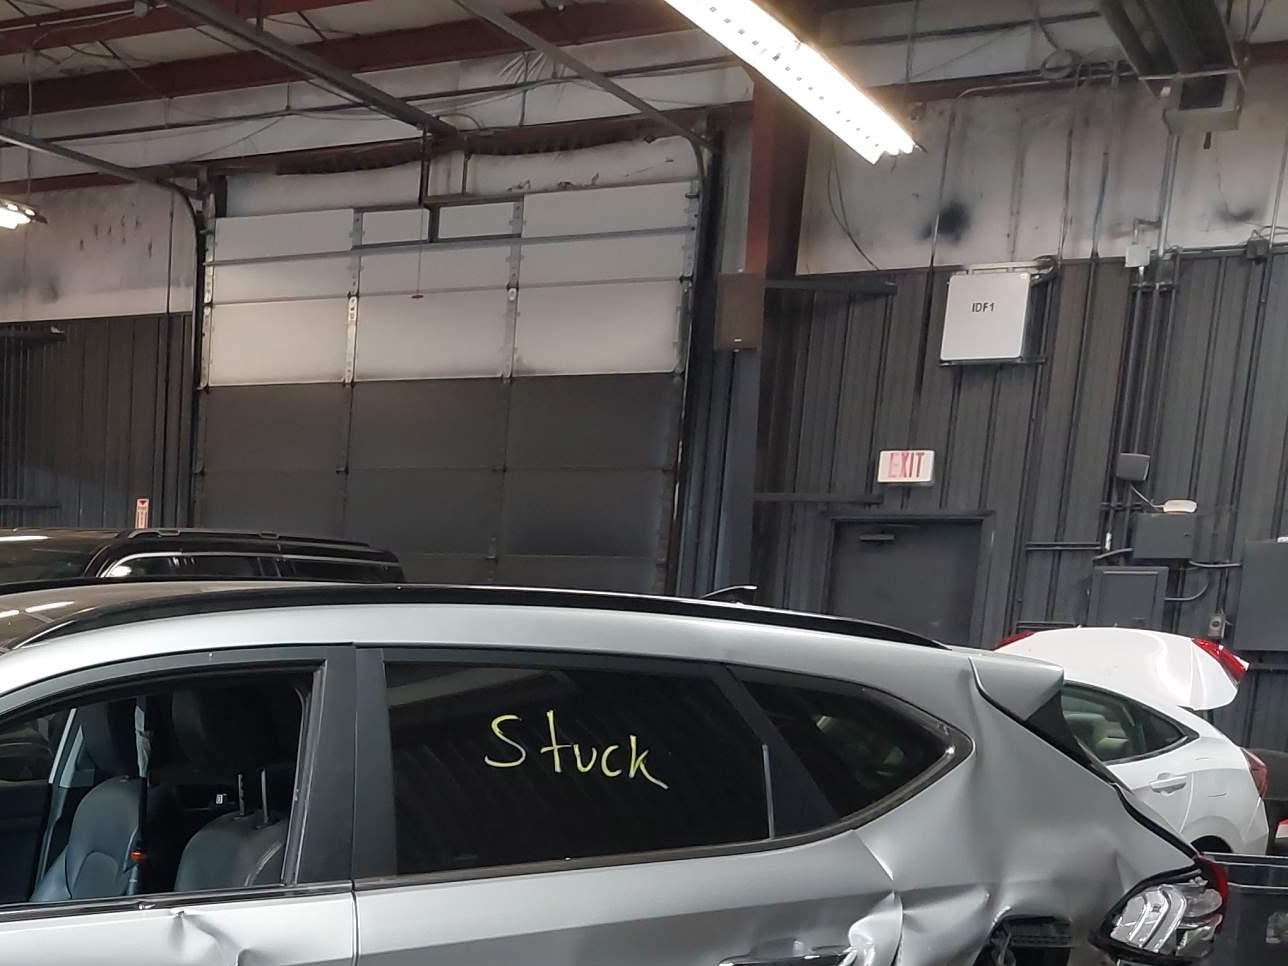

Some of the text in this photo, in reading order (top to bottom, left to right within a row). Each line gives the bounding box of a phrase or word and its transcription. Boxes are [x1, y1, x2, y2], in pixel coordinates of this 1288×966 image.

[972, 302, 995, 313] IDF1
[888, 452, 925, 478] EXIT
[484, 710, 669, 789] Stuck
